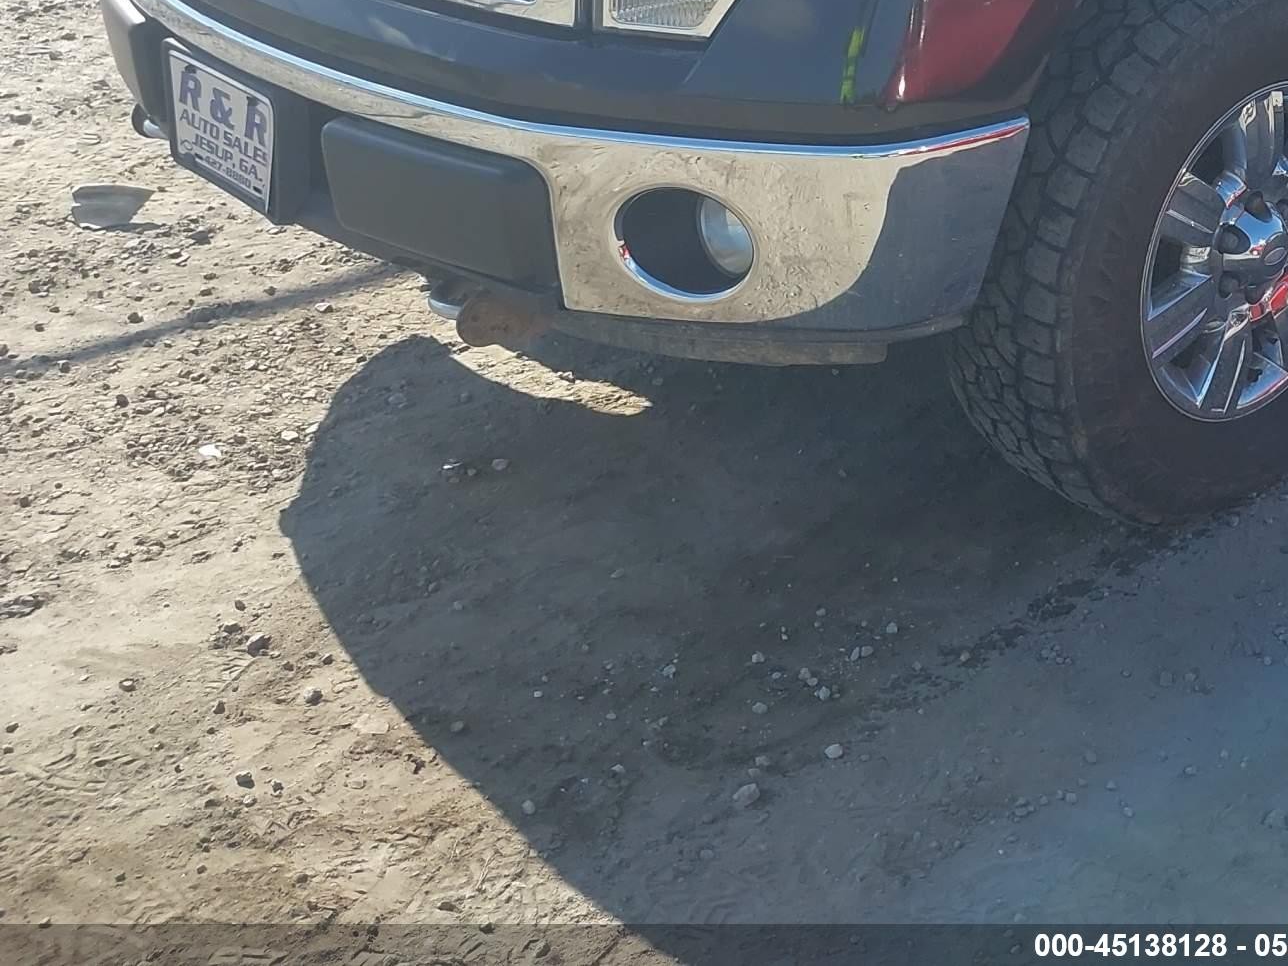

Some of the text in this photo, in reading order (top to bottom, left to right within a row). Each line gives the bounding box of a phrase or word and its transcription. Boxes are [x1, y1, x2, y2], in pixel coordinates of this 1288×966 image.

[179, 70, 267, 147] R & R
[179, 109, 220, 139] AUTO
[192, 134, 236, 168] JESUP,
